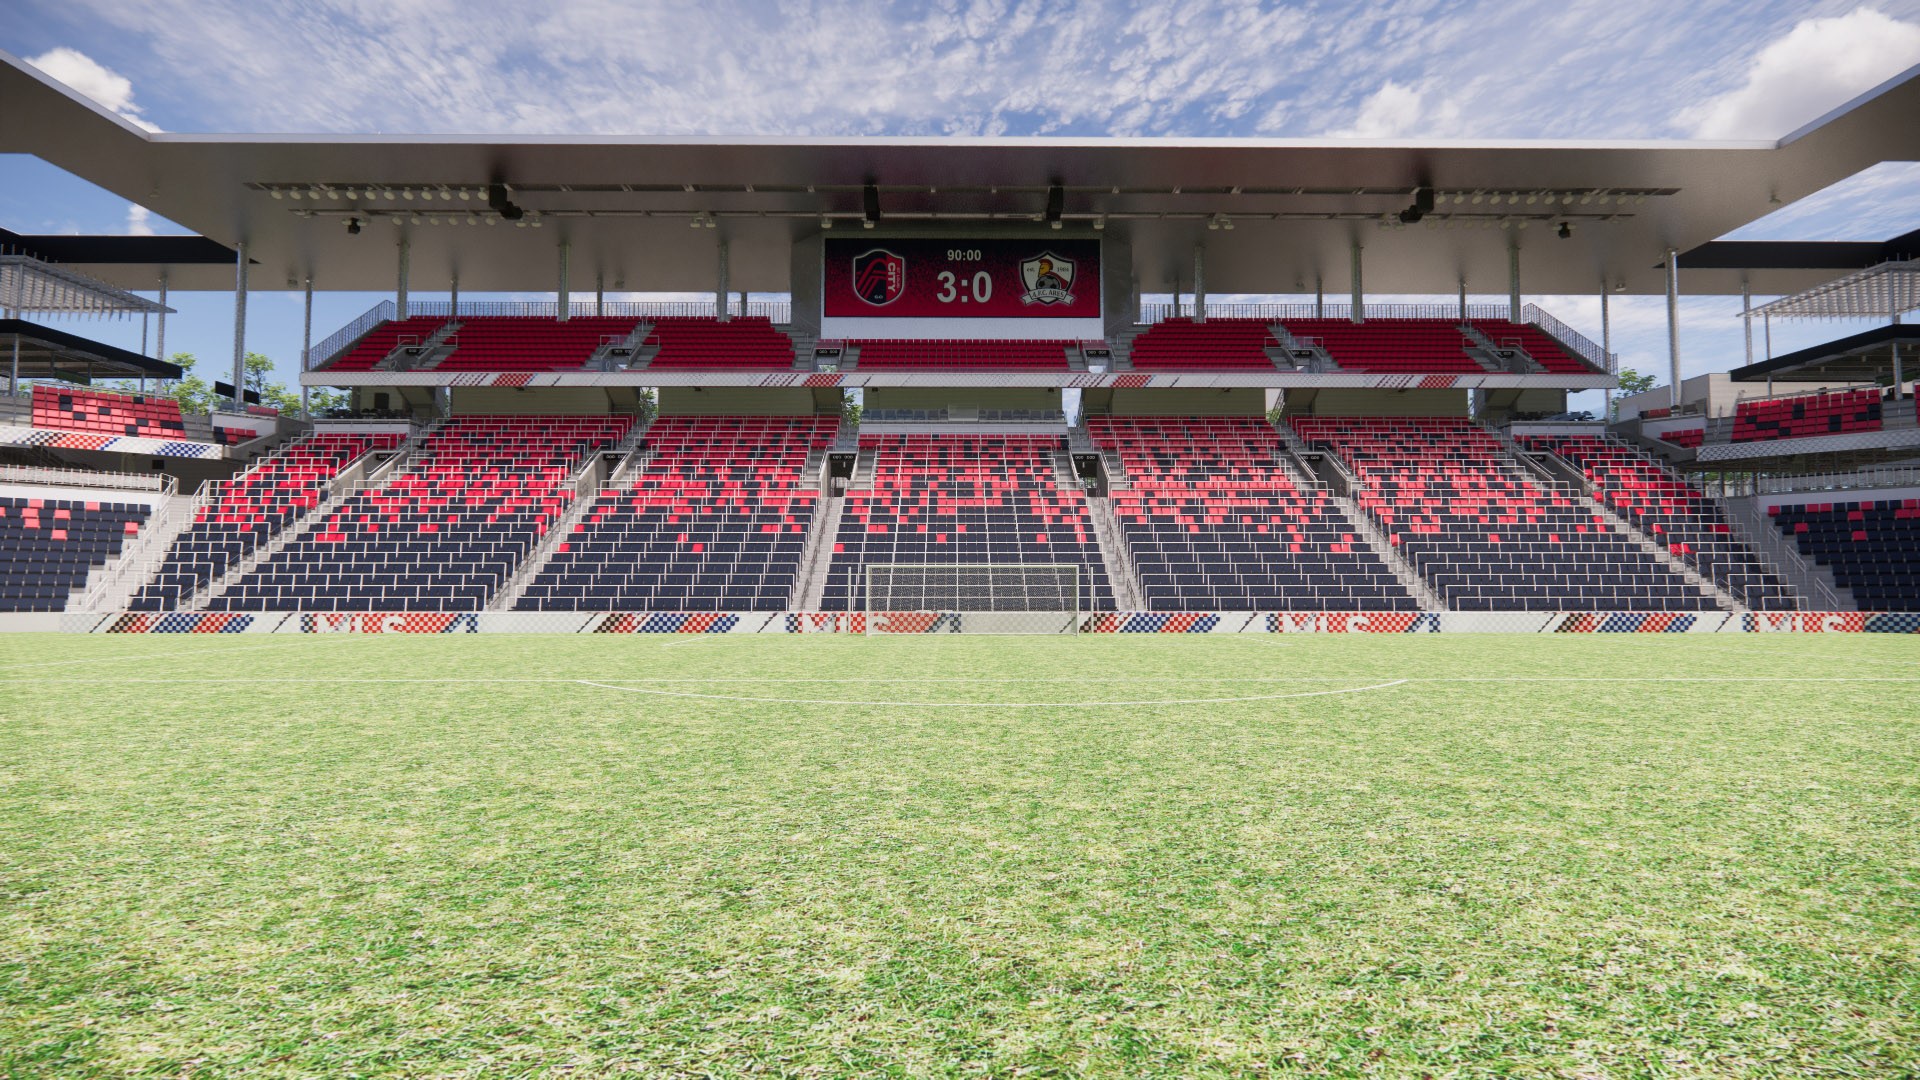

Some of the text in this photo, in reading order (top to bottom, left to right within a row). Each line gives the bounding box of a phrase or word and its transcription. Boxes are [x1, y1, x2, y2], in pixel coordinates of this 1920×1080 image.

[947, 249, 981, 261] 90:00
[887, 262, 896, 293] CITY
[936, 270, 993, 303] 3:0
[1048, 289, 1065, 298] ARES
